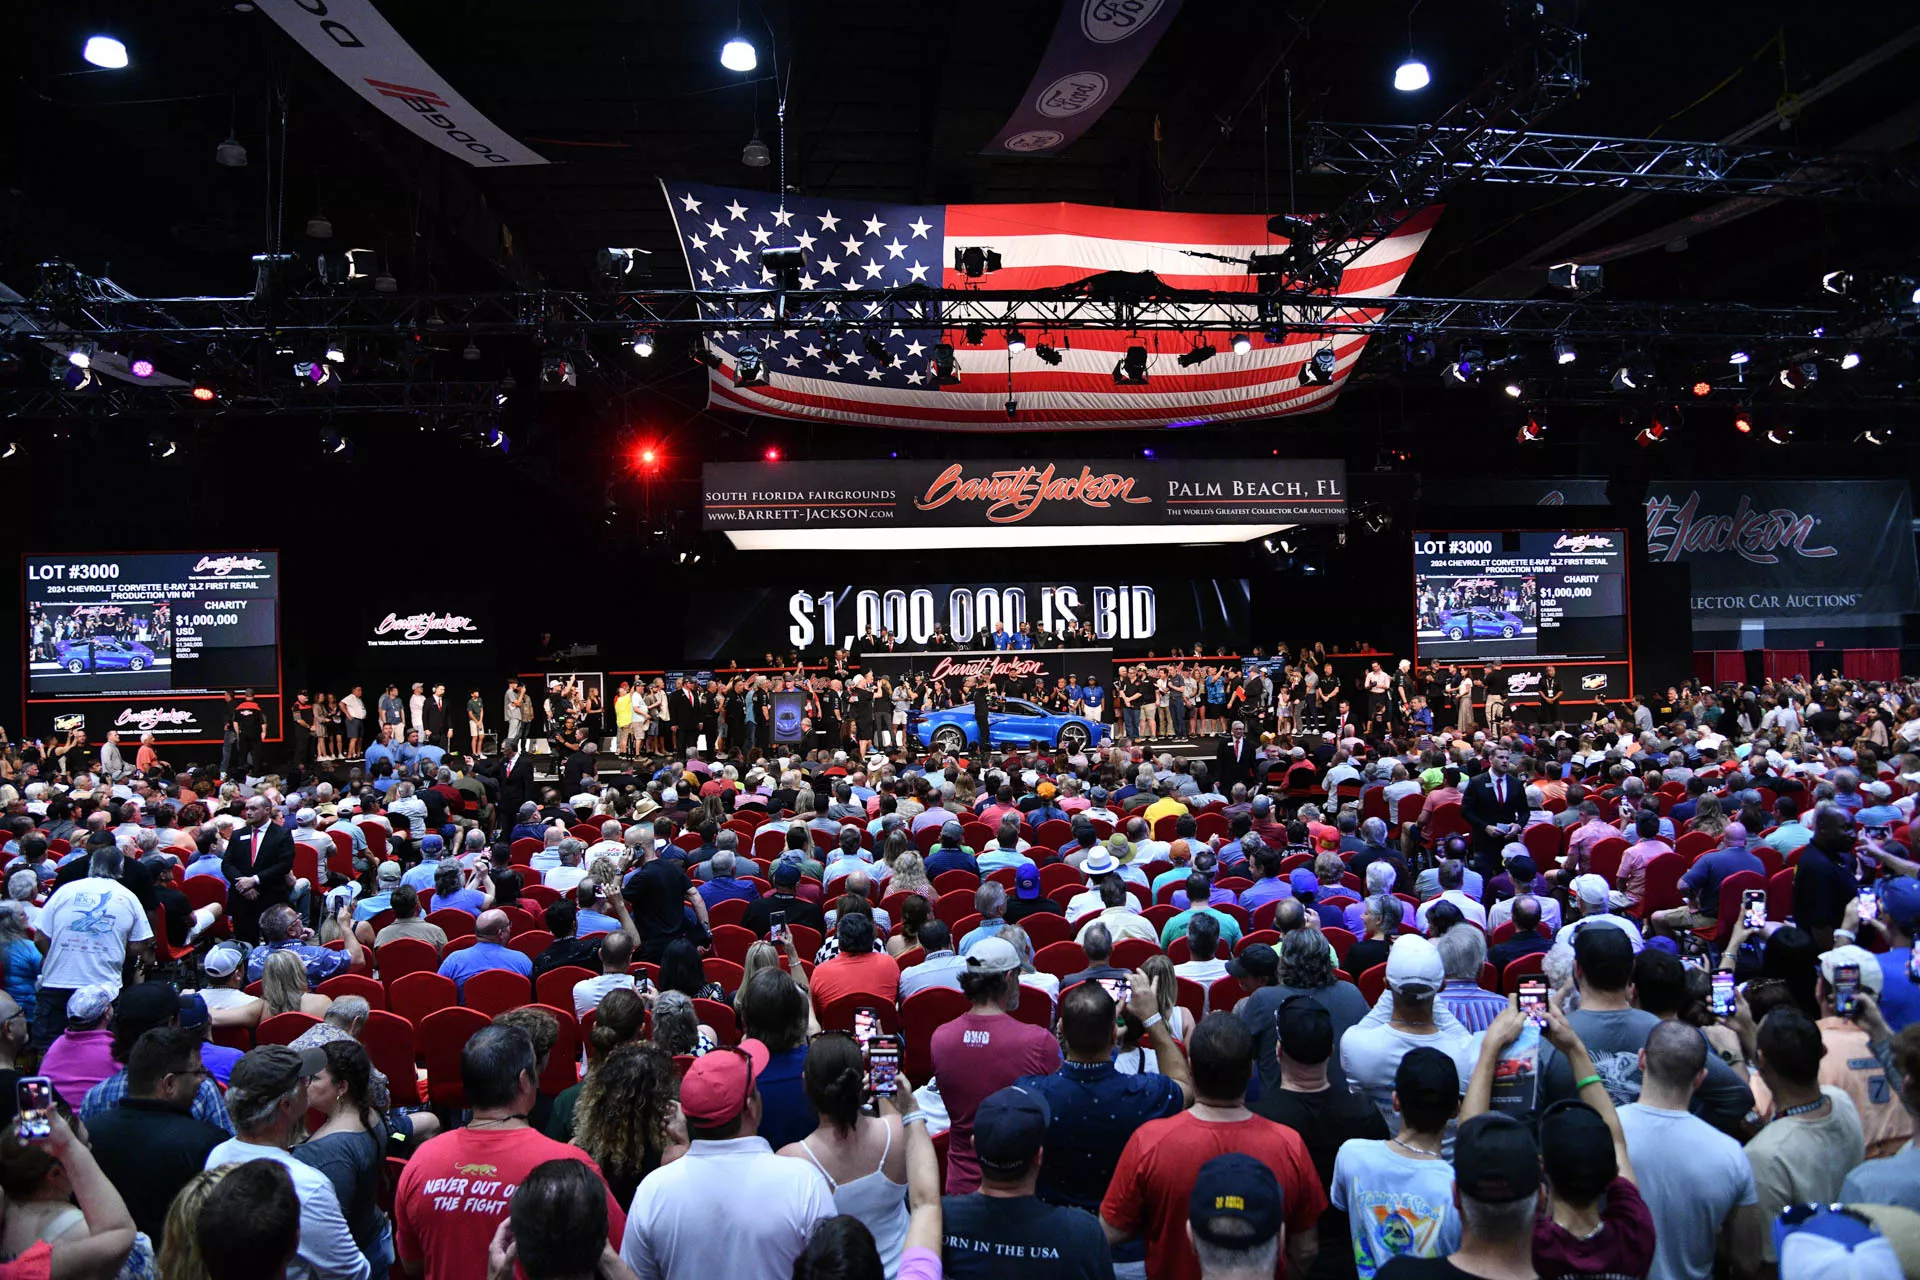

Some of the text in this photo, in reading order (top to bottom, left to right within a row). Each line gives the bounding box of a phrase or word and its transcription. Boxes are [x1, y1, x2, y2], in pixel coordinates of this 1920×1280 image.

[1046, 82, 1099, 111] Ford
[400, 96, 511, 163] DODGE
[705, 490, 896, 501] SOUTH FLORIDA FAIRGROUNDS
[914, 462, 1152, 524] Barrett-Jackson
[1167, 479, 1341, 498] PALM BEACH, FL
[1215, 507, 1250, 515] GREATEST
[1251, 507, 1292, 515] COLLECTOR
[1414, 540, 1493, 554] LOT #3000
[1448, 559, 1490, 567] CHEVROLET
[1491, 558, 1528, 566] CORVETTE
[1529, 558, 1550, 566] E-RAY
[28, 563, 120, 580] LOT #3000
[1563, 575, 1599, 583] CHARITY
[47, 581, 259, 593] 2024 CHEVROLET CORVETTE E-RAY 3LZ FIRST RETAIL
[1540, 587, 1592, 599] $1,000,000
[111, 591, 165, 600] PRODUCTION
[166, 591, 180, 599] VIN
[1749, 594, 1780, 609] CAR
[204, 600, 248, 610] CHARITY
[175, 614, 238, 627] $1,000,000
[789, 588, 1027, 651] $1,000000
[1094, 585, 1156, 640] BID
[175, 627, 195, 636] USD
[930, 656, 1050, 682] Barrett-Jackson
[1871, 1079, 1885, 1099] 7
[424, 1177, 469, 1196] NEVER
[470, 1180, 502, 1196] OUT
[433, 1196, 507, 1215] THE FIGHT
[942, 1235, 1059, 1258] ORN IN THE USA
